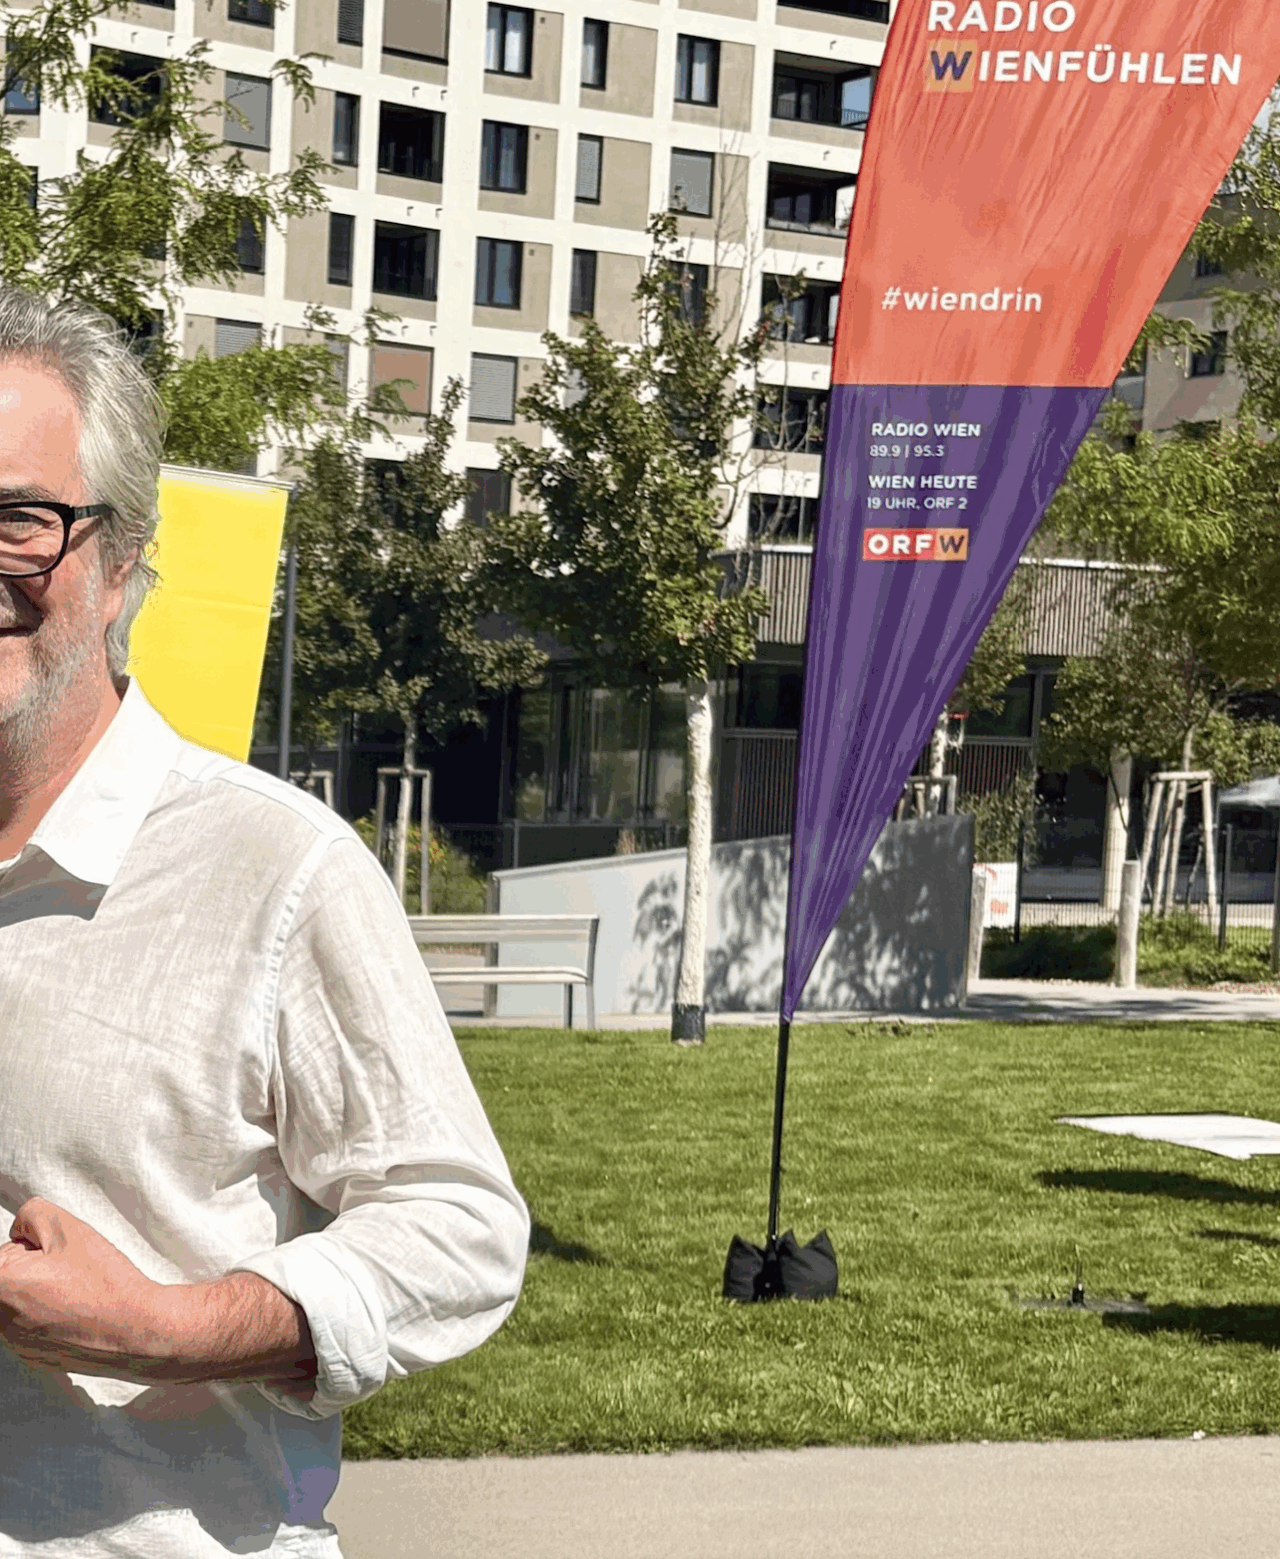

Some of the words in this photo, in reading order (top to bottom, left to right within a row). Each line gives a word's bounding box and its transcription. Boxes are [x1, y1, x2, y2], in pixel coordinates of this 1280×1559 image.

[927, 0, 1076, 32] RADIO
[929, 43, 1242, 86] WIENFÜHLEN
[881, 286, 1042, 312] #wiendrin
[871, 422, 928, 437] RADIO
[933, 423, 981, 437] WIEN
[869, 444, 901, 457] 89.9
[913, 444, 945, 457] 95.3
[868, 475, 916, 489] WIEN
[920, 475, 978, 490] HEUTE
[867, 496, 881, 509] 19
[923, 497, 955, 510] ORF
[957, 497, 968, 510] 2
